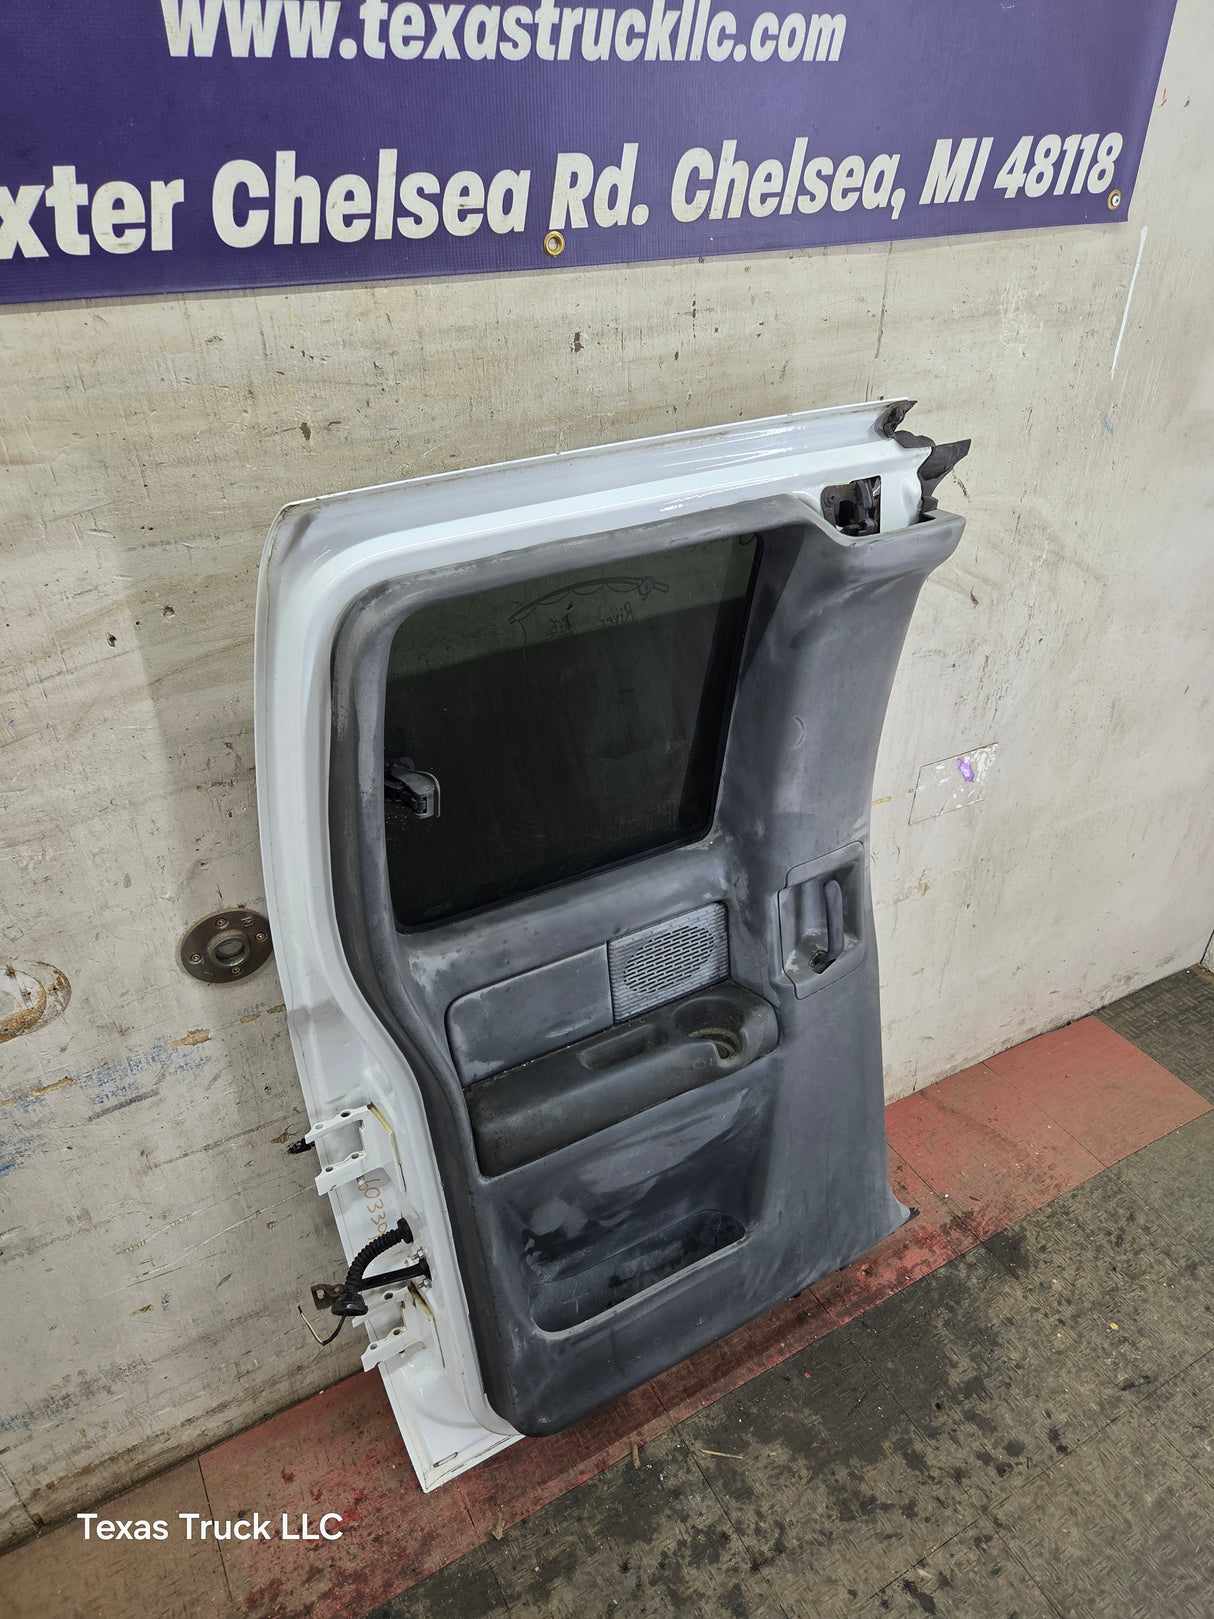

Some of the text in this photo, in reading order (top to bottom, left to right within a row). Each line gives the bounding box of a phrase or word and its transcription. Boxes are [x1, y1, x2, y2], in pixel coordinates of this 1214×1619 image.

[160, 0, 847, 63] www.texastruckllc.com
[0, 132, 1124, 260] xter Chelsea Rd. Chelsea, MI 48118
